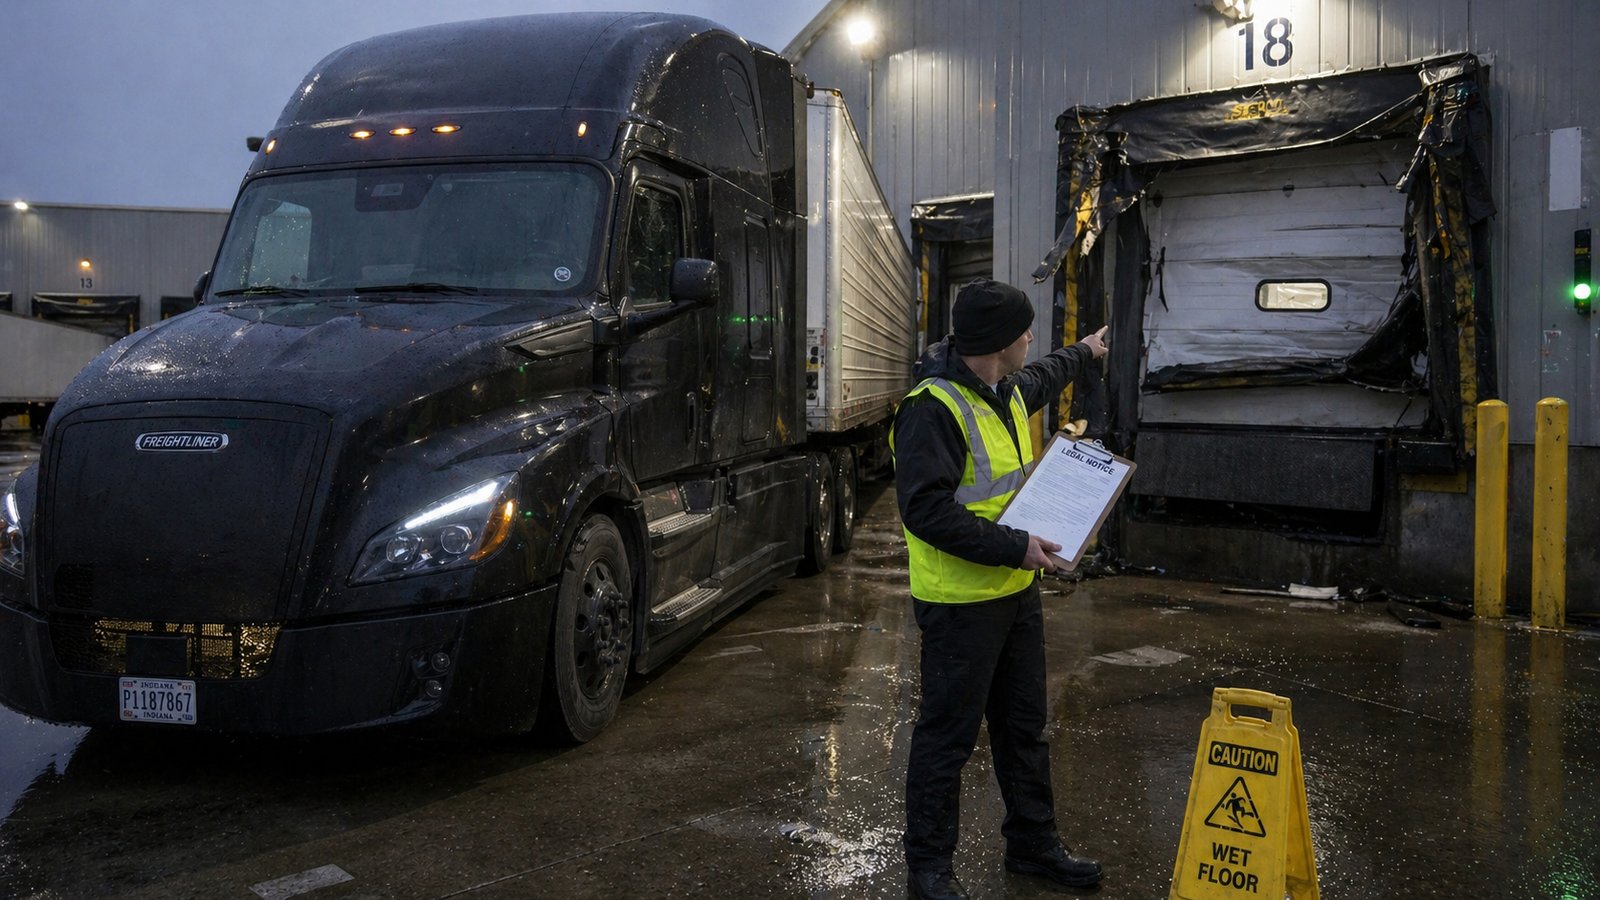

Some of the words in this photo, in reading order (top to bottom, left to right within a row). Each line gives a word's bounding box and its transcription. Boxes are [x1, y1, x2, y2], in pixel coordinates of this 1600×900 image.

[1239, 17, 1293, 71] 18
[80, 277, 93, 289] 13
[142, 436, 219, 447] FREIGHTLINER
[1061, 447, 1085, 462] LEGAL
[1085, 457, 1115, 475] NOTICE
[123, 689, 192, 713] P1187867
[143, 711, 174, 720] INDIANA
[1211, 744, 1277, 773] CAUTION
[1212, 842, 1252, 867] WET
[1198, 862, 1259, 893] FLOOR
